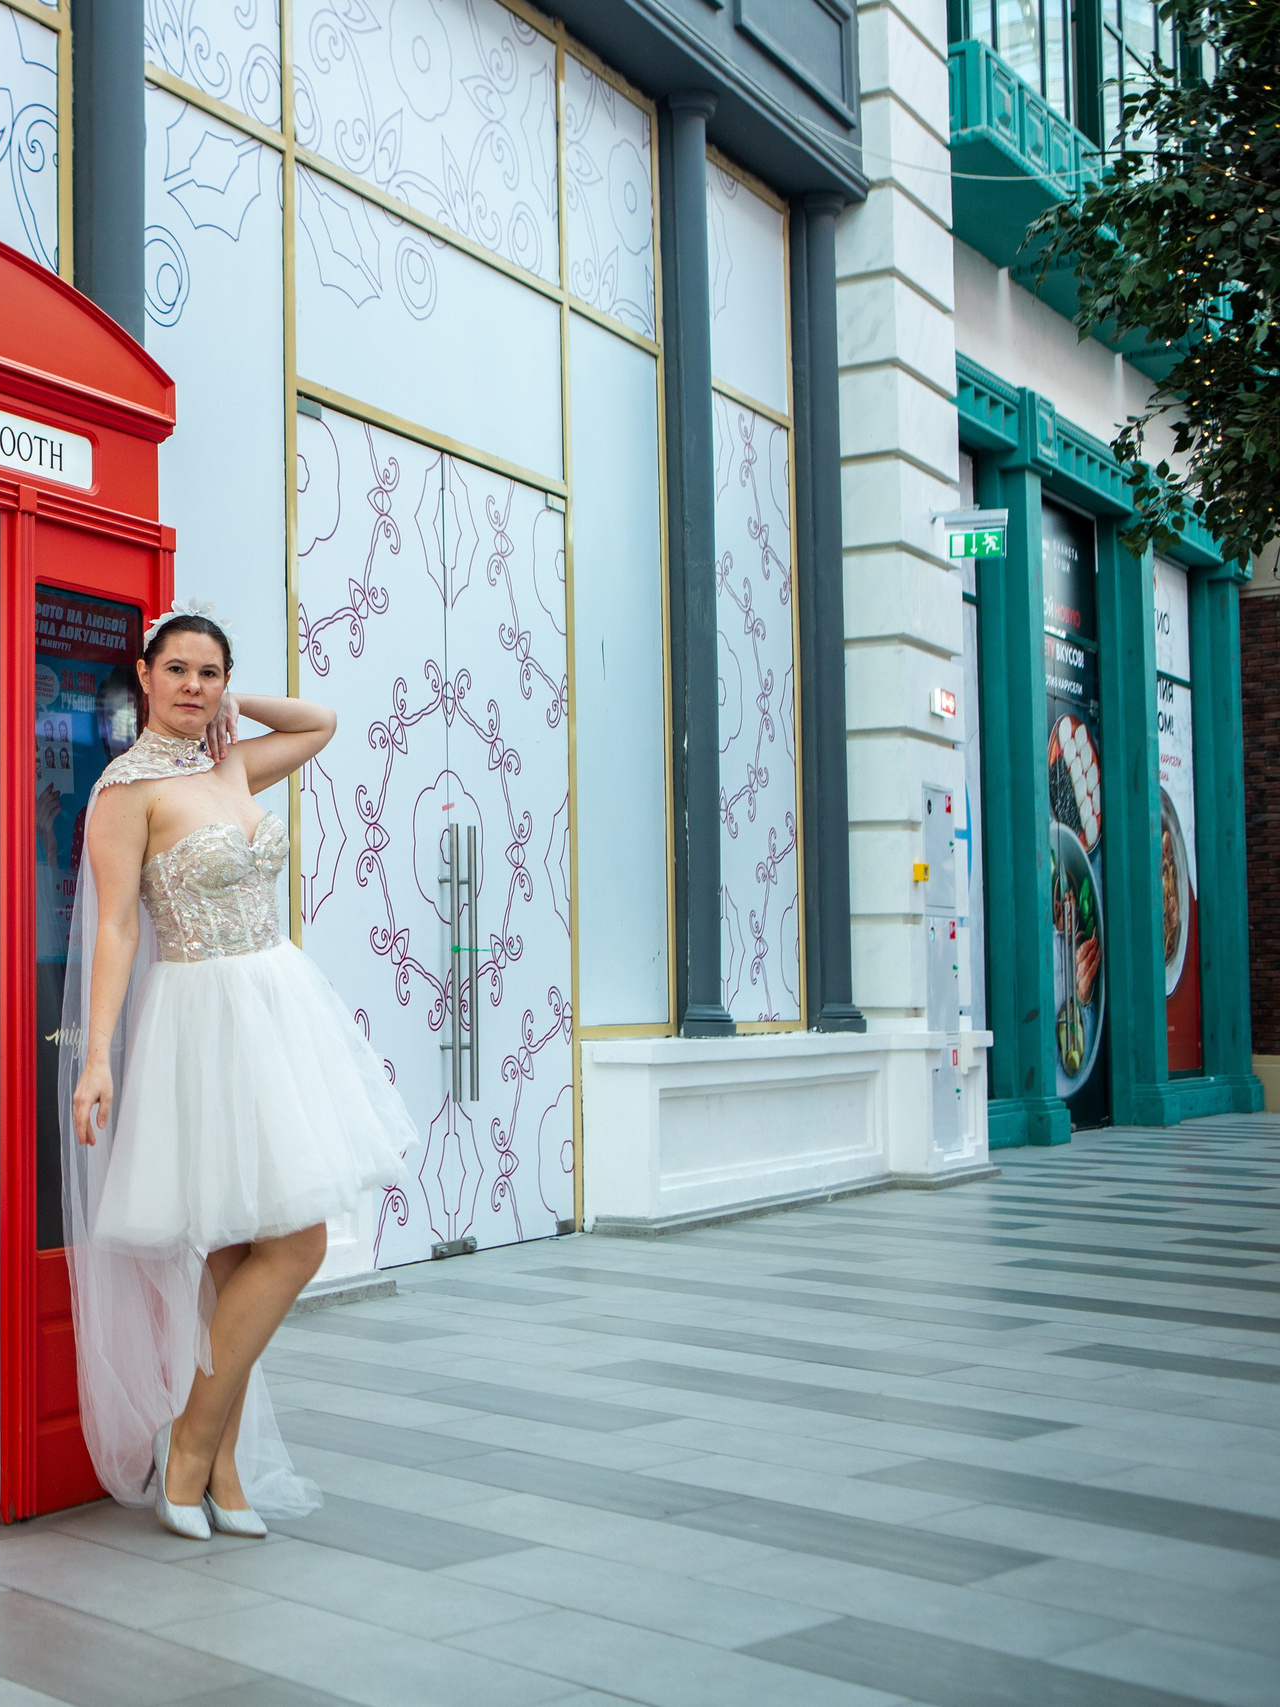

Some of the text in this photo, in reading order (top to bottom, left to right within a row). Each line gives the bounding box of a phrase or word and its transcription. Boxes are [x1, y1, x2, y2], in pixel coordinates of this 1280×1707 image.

[67, 608, 82, 625] НА
[85, 612, 127, 634] ЛЮБОЙ
[1054, 603, 1081, 629] НОВУЮ
[40, 639, 72, 652] МИНУТУ!
[58, 624, 127, 651] ДОКУМЕНТА
[1045, 639, 1085, 669] ЕТУ ВКУСОВ!
[61, 668, 96, 694] ЗА 300
[1158, 710, 1174, 736] ОМ!
